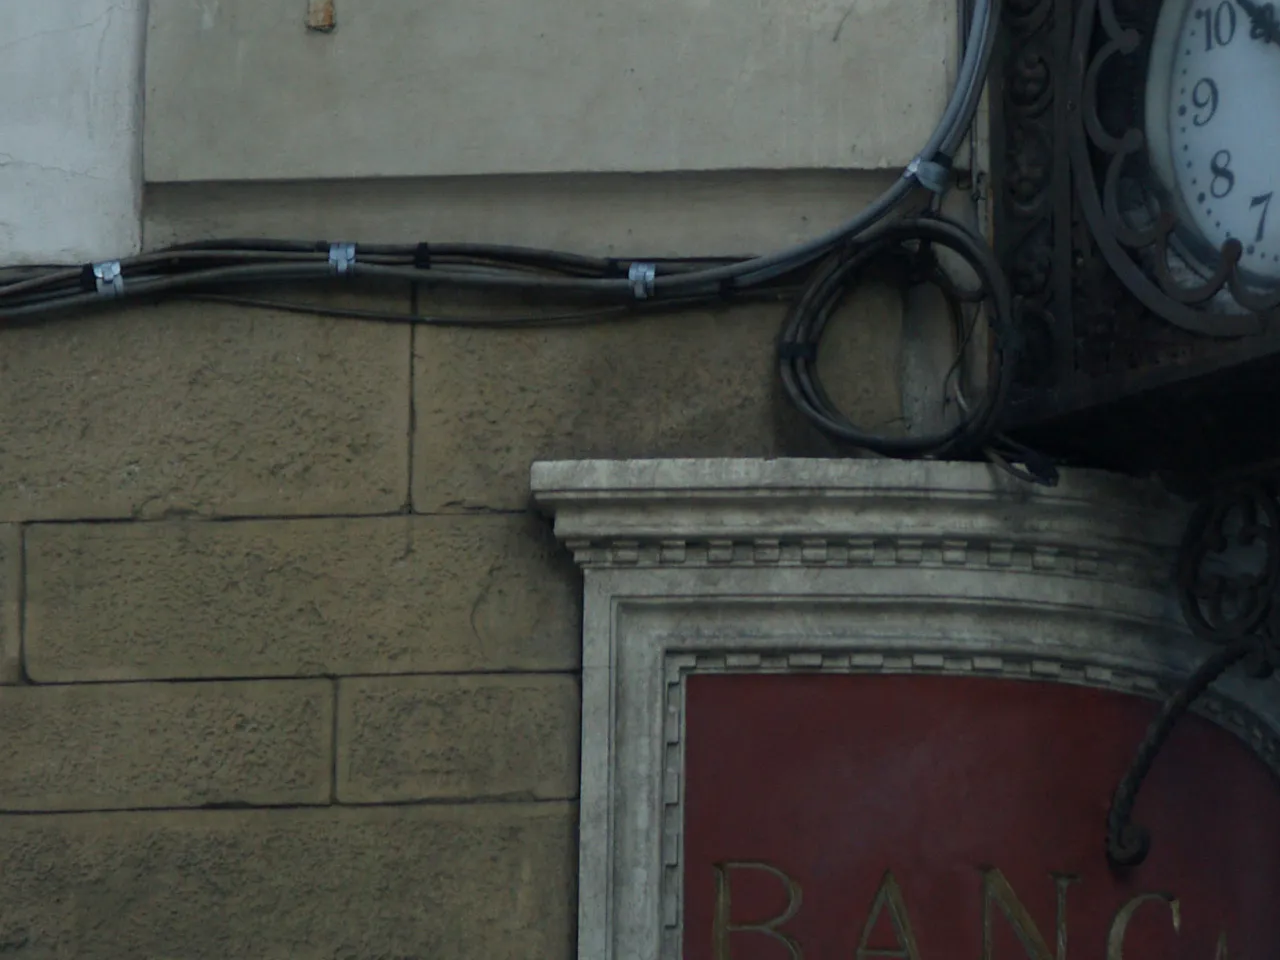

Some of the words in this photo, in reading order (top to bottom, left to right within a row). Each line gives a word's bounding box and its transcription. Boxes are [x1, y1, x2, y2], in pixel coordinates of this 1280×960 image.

[1200, 0, 1237, 52] 10
[1192, 77, 1219, 127] 9
[1209, 149, 1235, 199] 8
[1249, 191, 1274, 243] 7
[713, 860, 1234, 960] BANC
